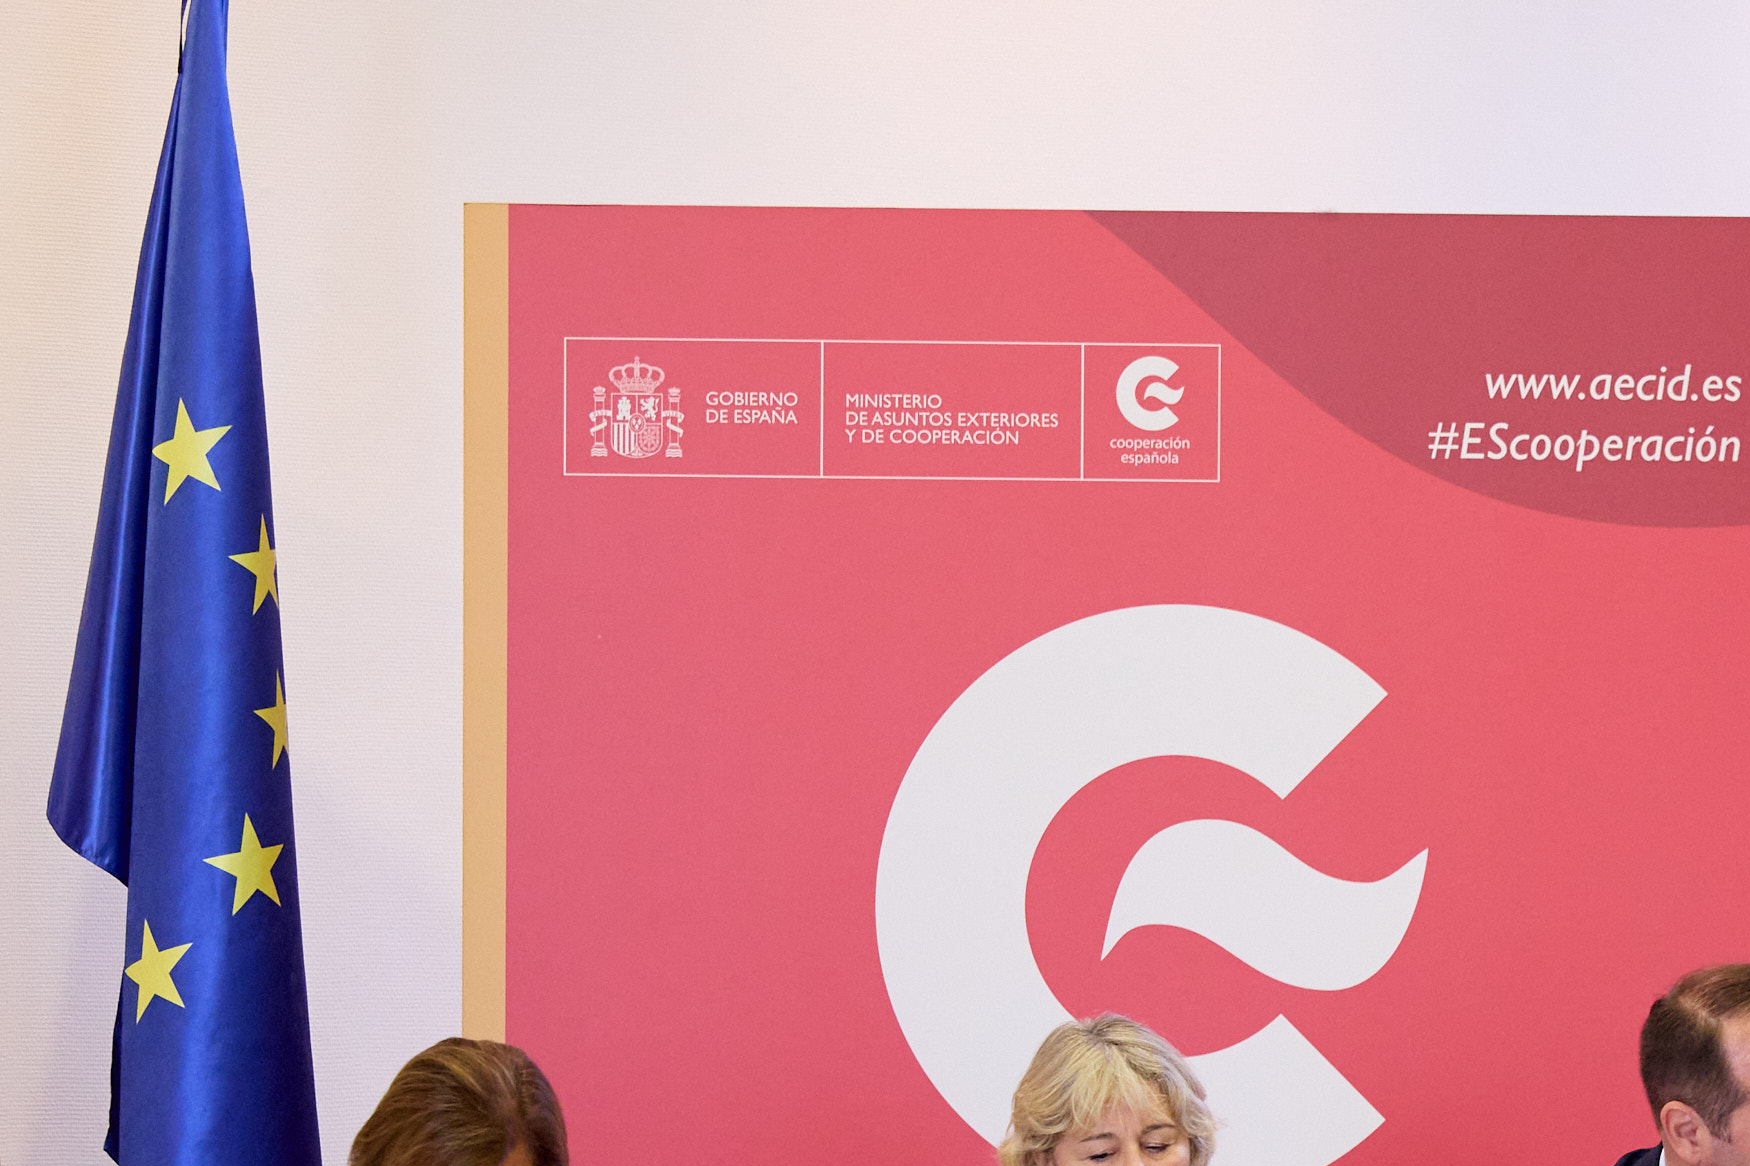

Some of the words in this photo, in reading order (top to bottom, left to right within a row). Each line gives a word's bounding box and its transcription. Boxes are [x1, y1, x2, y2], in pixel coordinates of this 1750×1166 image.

[1486, 364, 1741, 401] www.aecid.es
[706, 391, 798, 406] GOBIERNO
[845, 395, 942, 409] MINISTERIO
[706, 409, 729, 423] DE
[734, 405, 798, 424] ESPAÑA
[845, 412, 868, 426] DE
[871, 412, 953, 427] ASUNTOS
[957, 413, 1059, 428] EXTERIORES
[845, 429, 857, 443] Y
[861, 429, 884, 444] DE
[890, 426, 1019, 445] COOPERACIÓN
[1109, 436, 1190, 452] cooperación
[1428, 422, 1740, 471] #EScooperación
[1121, 452, 1179, 467] española
